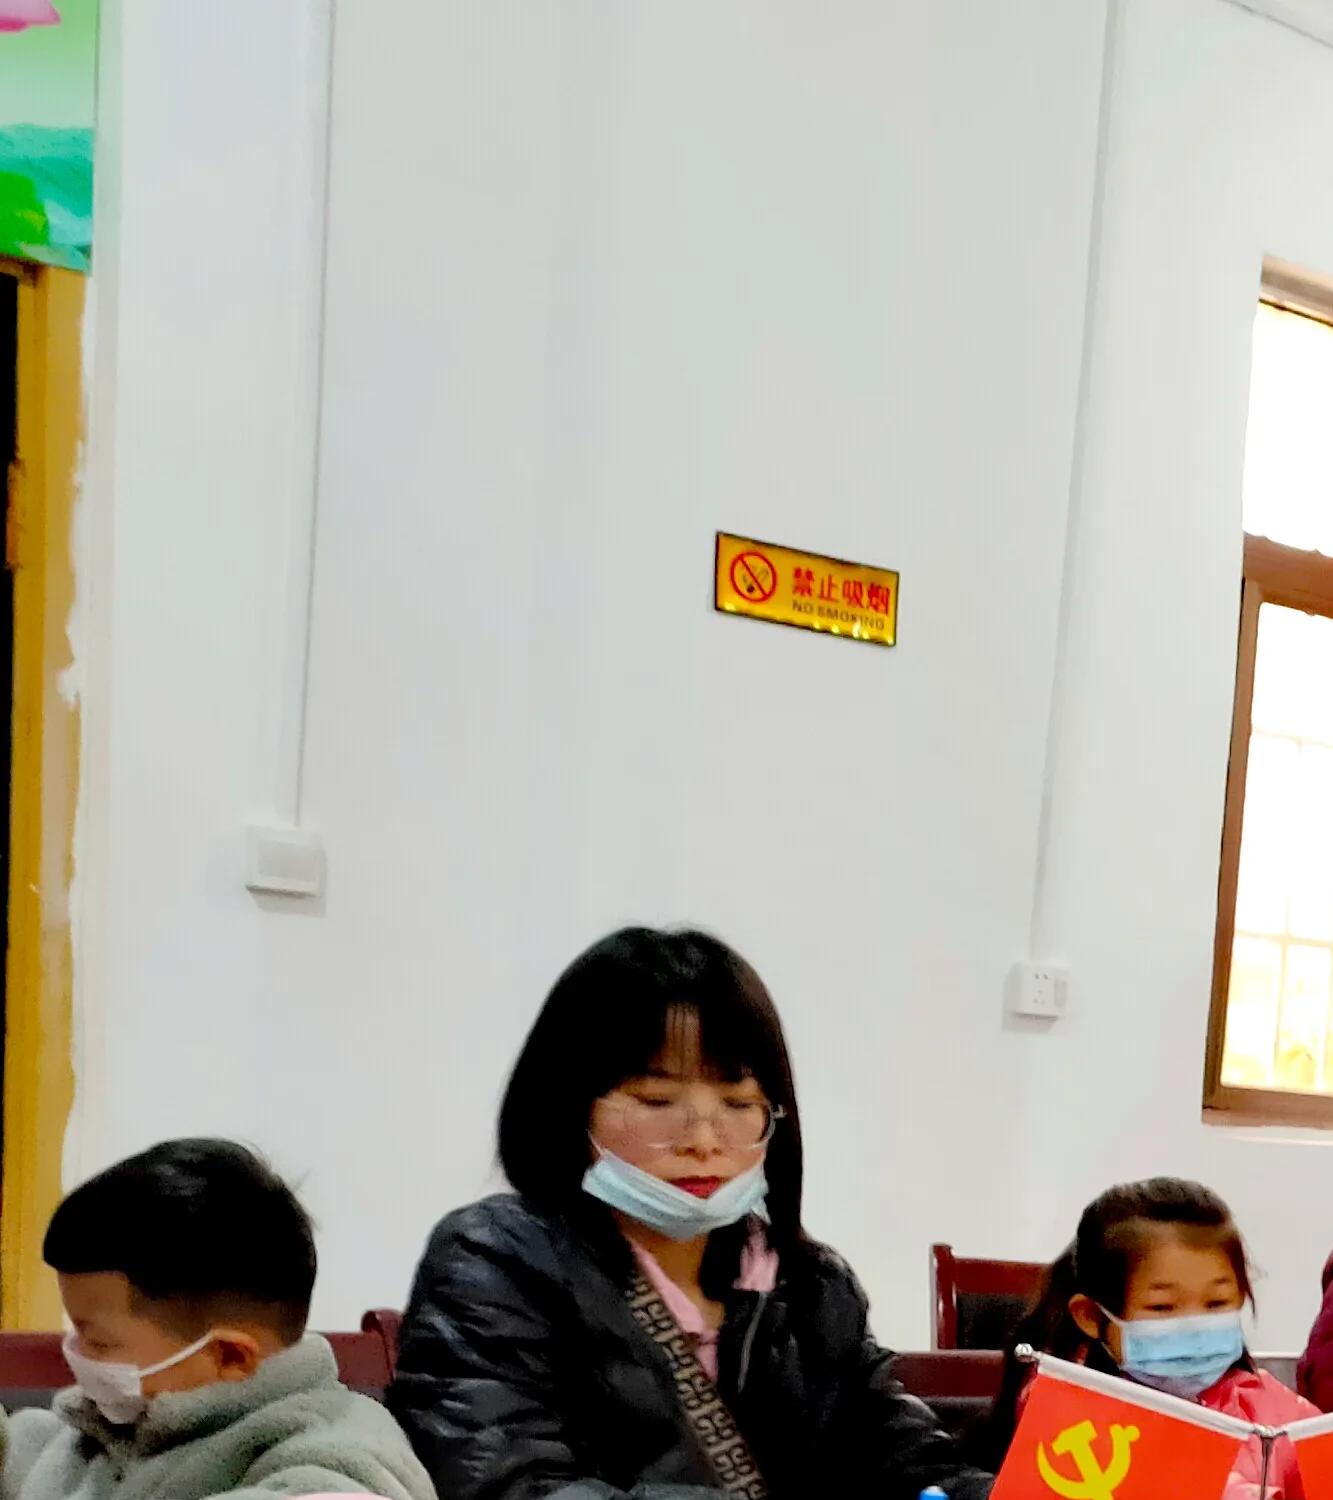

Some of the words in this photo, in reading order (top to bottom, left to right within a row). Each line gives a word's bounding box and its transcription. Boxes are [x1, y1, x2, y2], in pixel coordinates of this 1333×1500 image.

[792, 566, 891, 616] 禁止吸烟
[792, 599, 815, 615] NO
